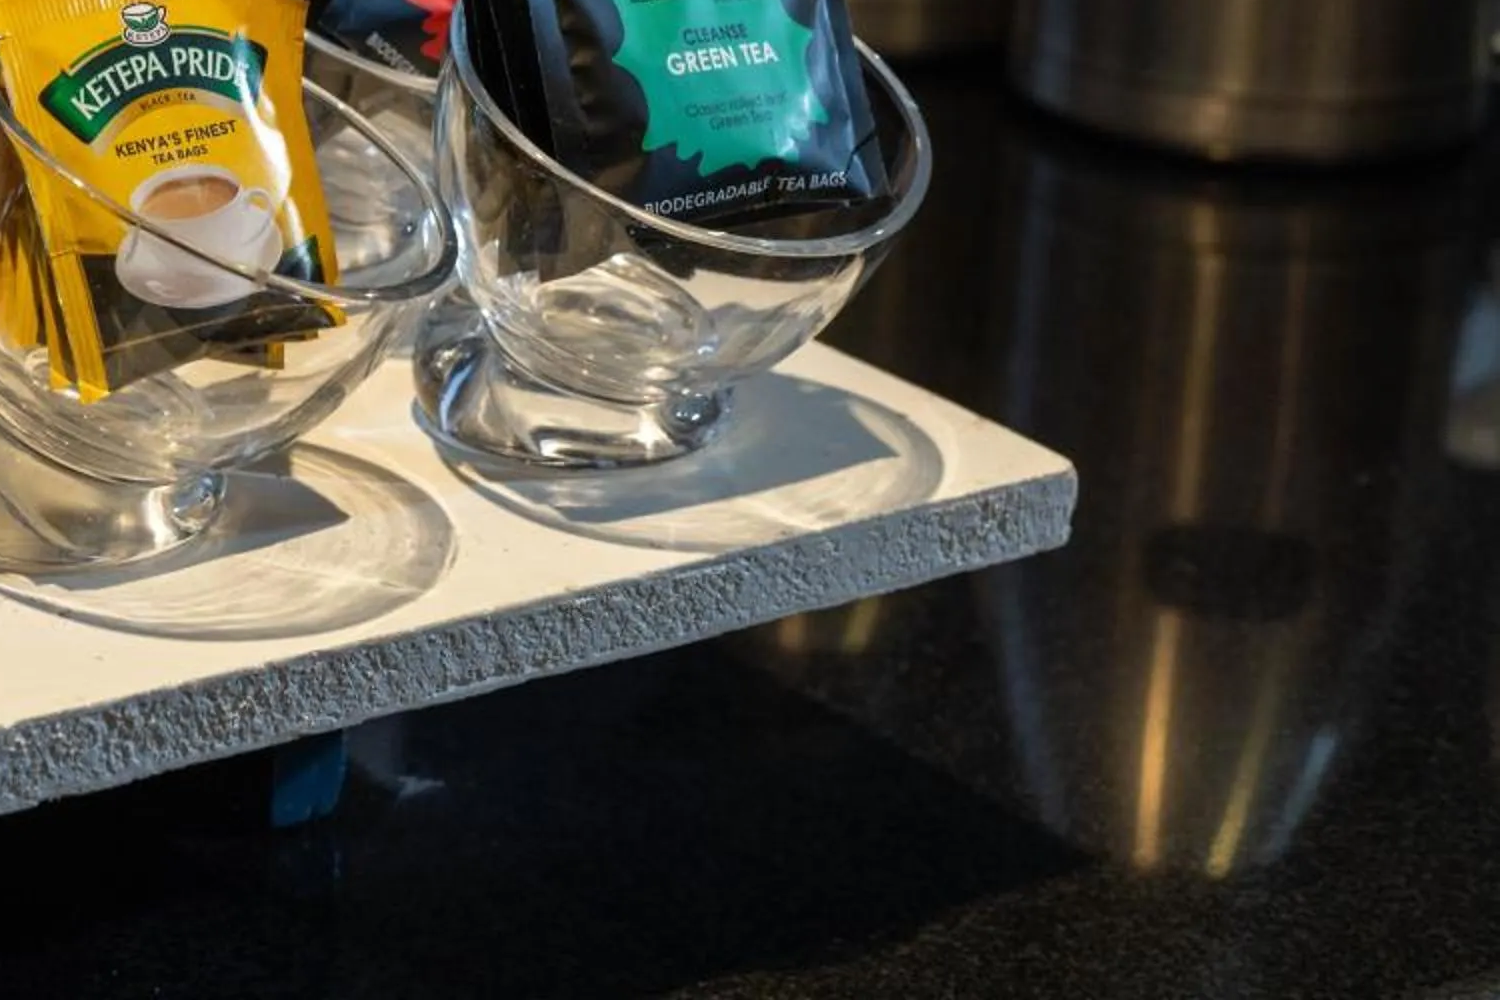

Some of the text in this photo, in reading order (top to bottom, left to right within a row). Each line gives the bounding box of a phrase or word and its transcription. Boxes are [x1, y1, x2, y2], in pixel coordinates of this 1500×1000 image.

[683, 22, 748, 46] CLEANSE
[666, 41, 779, 76] GREEN TEA
[71, 47, 250, 121] KETEPA PRIDE
[177, 91, 196, 102] TEA
[115, 119, 237, 158] KENYA'S FINEST
[151, 143, 209, 165] TEA BAGS
[776, 176, 806, 191] TEA
[809, 171, 848, 190] BAGS
